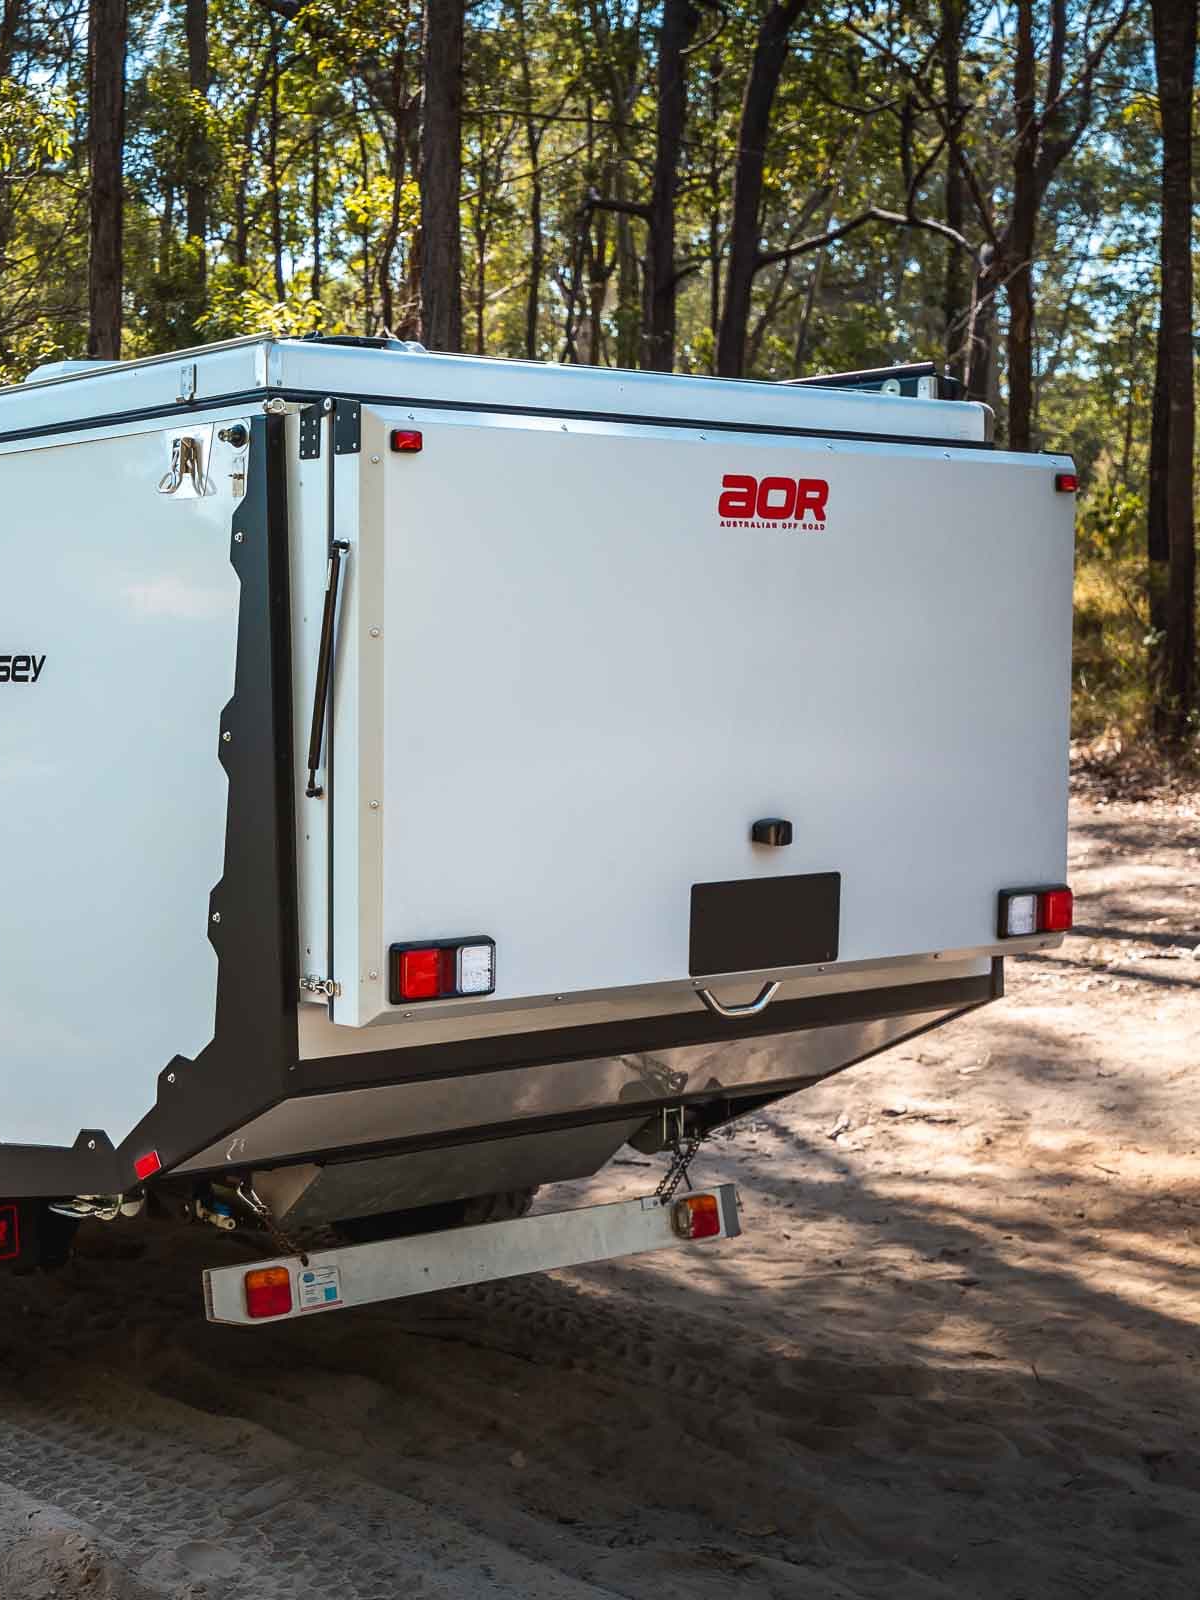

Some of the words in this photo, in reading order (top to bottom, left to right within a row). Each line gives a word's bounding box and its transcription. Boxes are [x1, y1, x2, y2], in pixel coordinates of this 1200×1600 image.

[719, 520, 778, 529] AUSTRALIAN
[781, 522, 798, 530] OFF
[802, 523, 826, 531] ROAD
